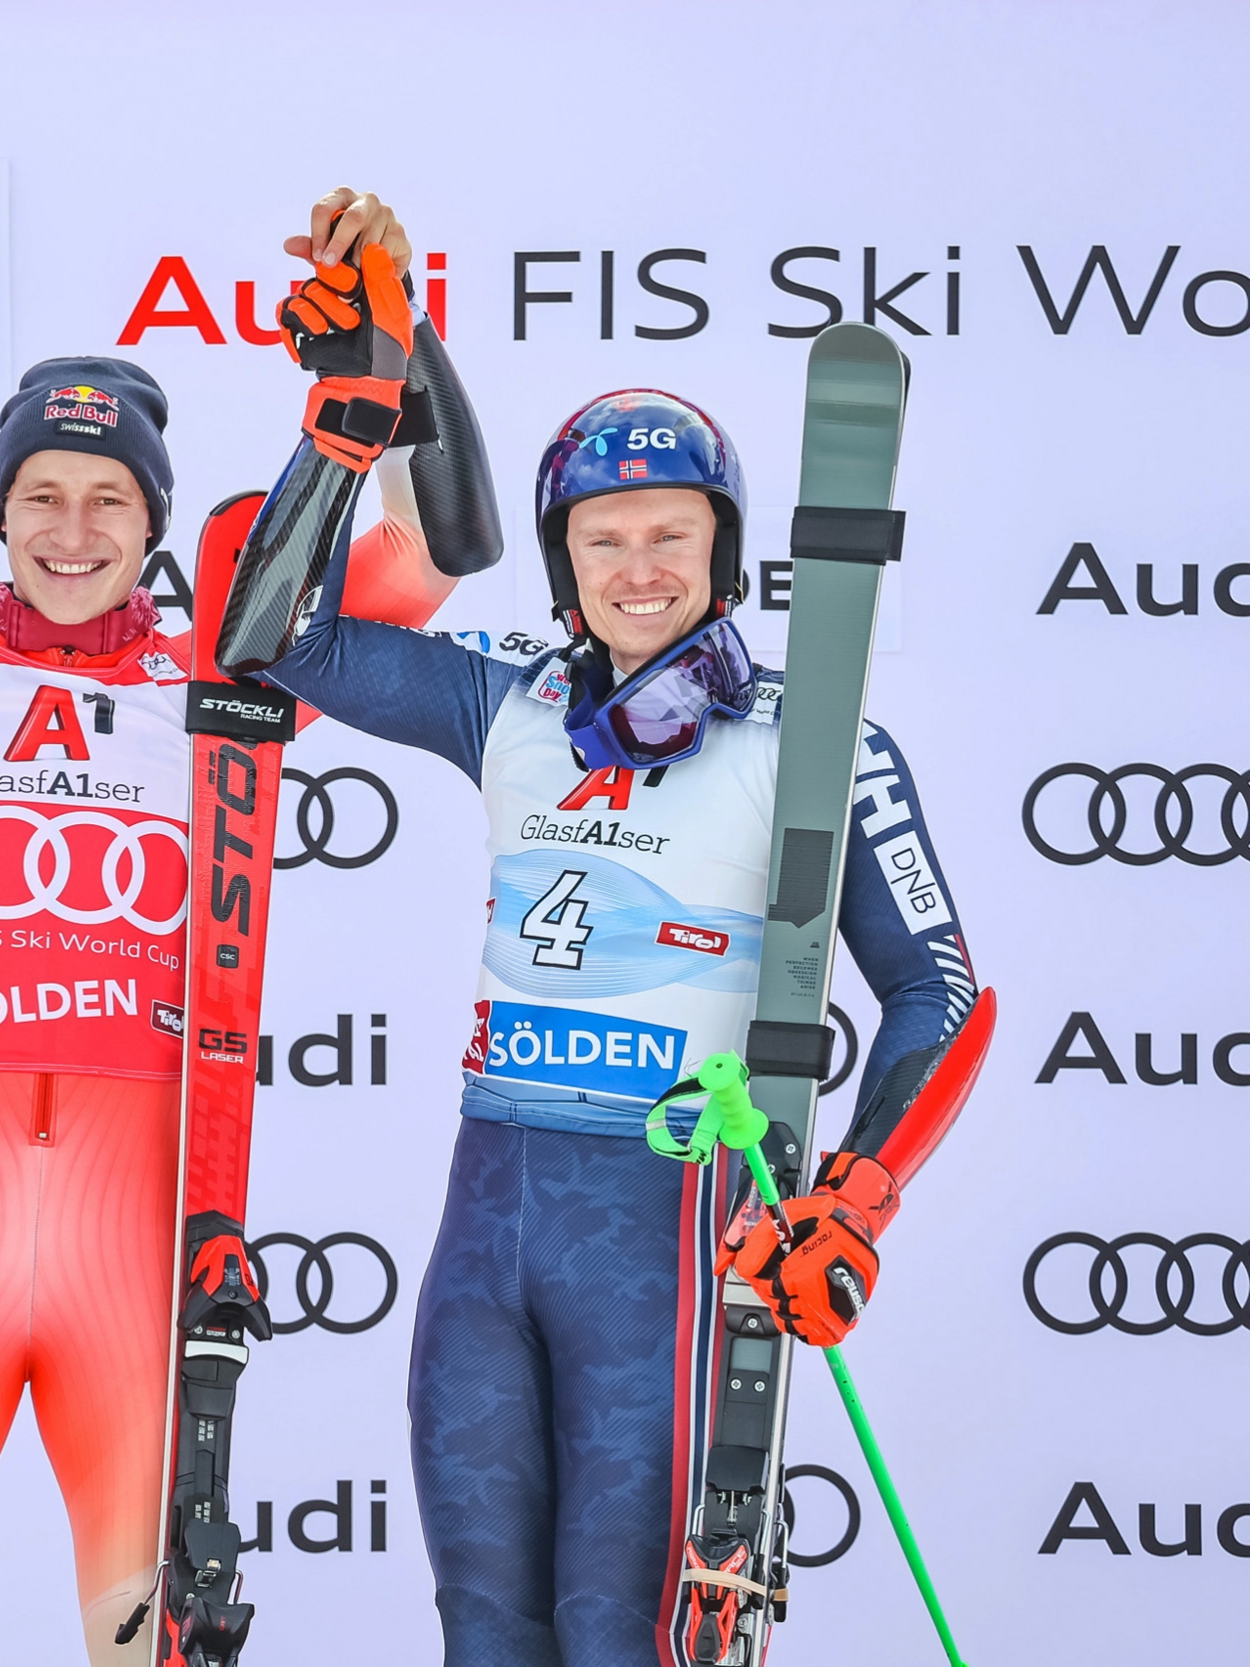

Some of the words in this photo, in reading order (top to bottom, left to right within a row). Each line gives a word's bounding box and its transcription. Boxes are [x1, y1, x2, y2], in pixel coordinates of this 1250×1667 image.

[117, 252, 447, 346] Aui
[513, 248, 709, 341] FIS
[767, 245, 960, 341] Ski
[44, 403, 81, 421] Red
[83, 405, 119, 428] Bull
[60, 421, 101, 436] swissski
[626, 427, 677, 451] 5G
[499, 632, 549, 656] 5G
[199, 698, 285, 719] STÖCKLI
[240, 713, 263, 722] RACING
[264, 716, 281, 724] TEAM
[520, 814, 671, 855] GlasfA1ser
[890, 847, 937, 914] DNB
[519, 869, 594, 971] 4
[10, 930, 51, 949] Ski
[58, 932, 141, 958] World
[146, 944, 180, 972] Cup
[669, 927, 722, 950] Tirol
[219, 951, 235, 961] CSC
[198, 1028, 248, 1054] GS
[488, 1020, 675, 1070] SÖLDEN
[200, 1051, 244, 1064] LASER
[801, 1230, 833, 1256] racing
